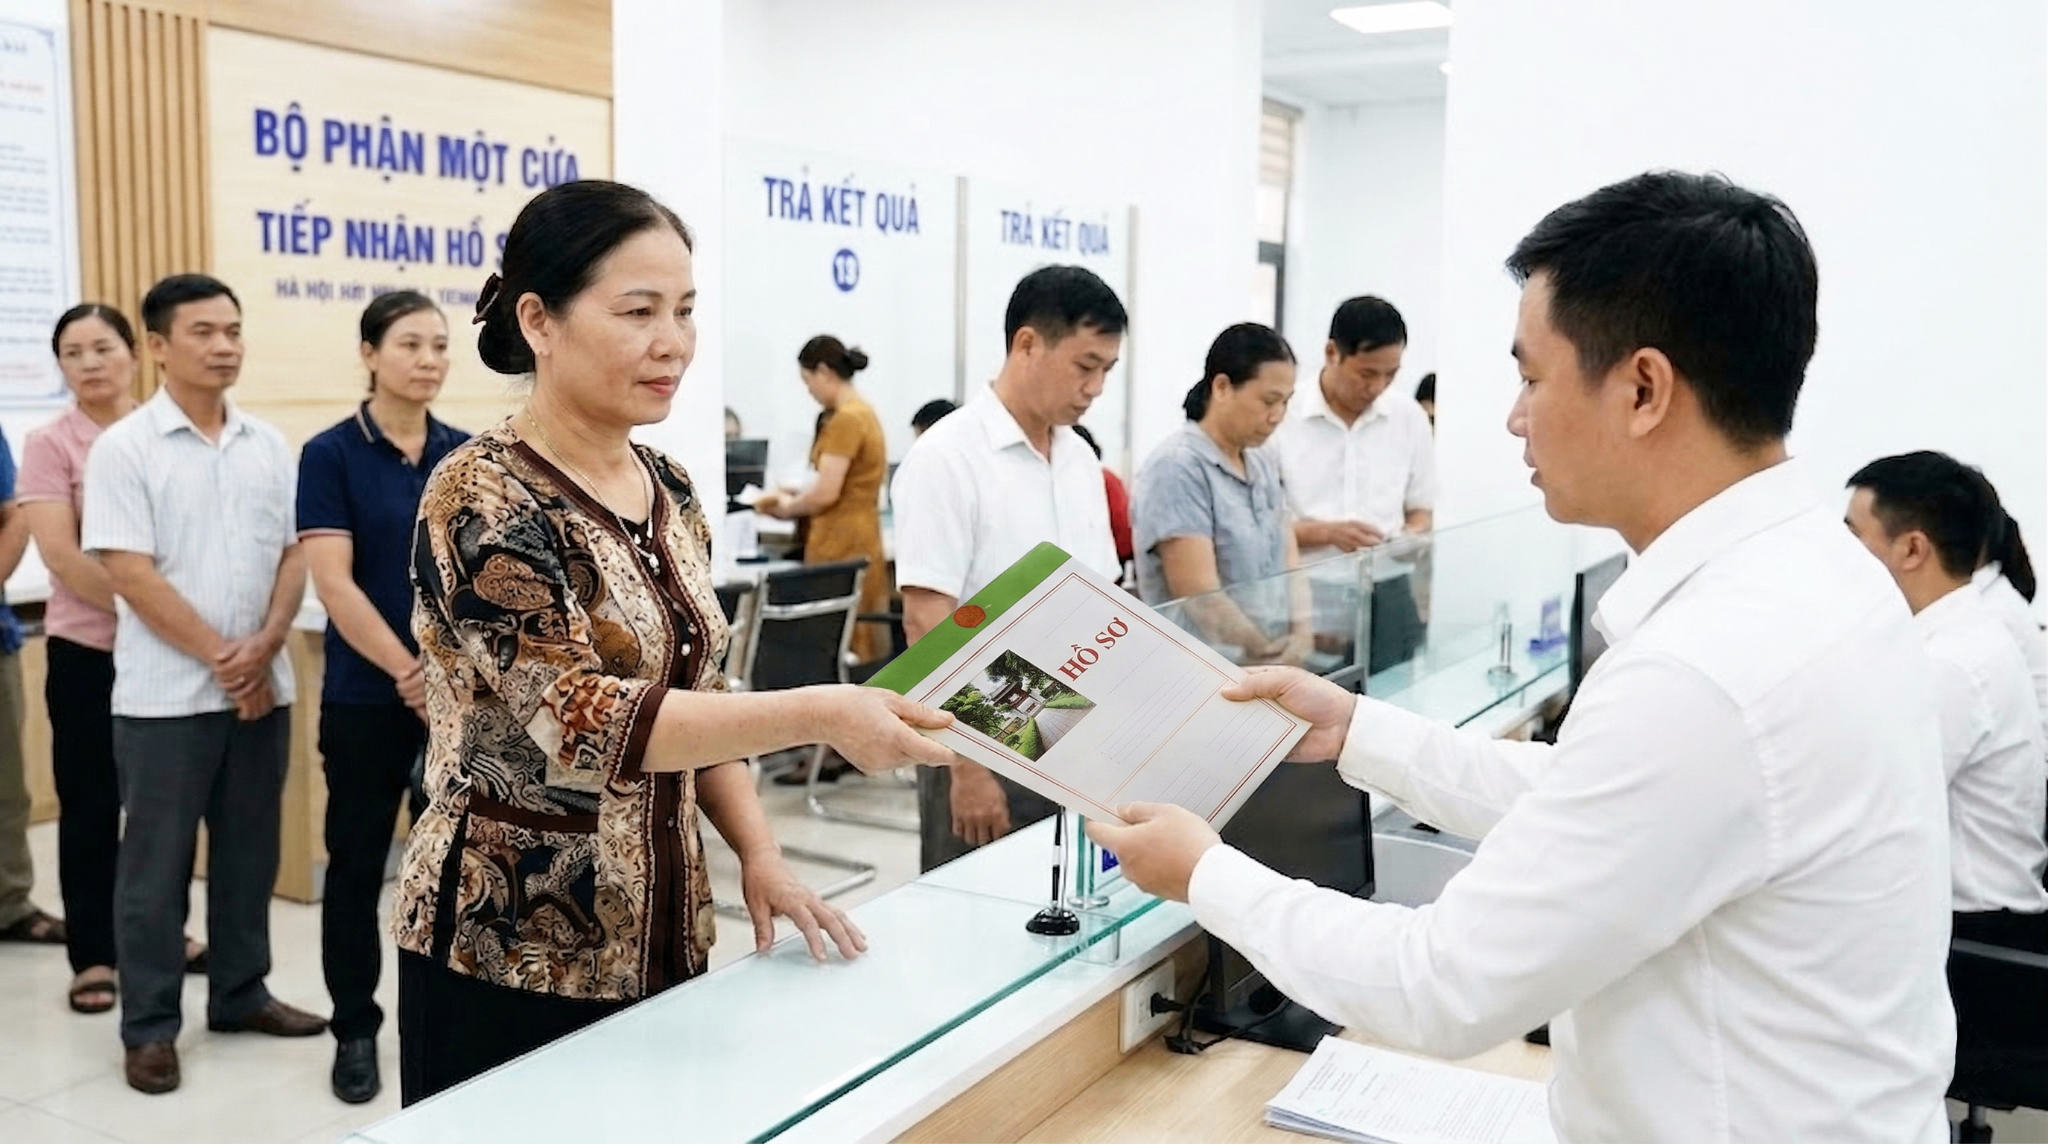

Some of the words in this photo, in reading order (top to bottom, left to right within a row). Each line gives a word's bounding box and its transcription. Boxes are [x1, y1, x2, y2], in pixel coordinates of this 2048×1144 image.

[255, 101, 308, 173] BỘ
[323, 115, 425, 183] PHẬN
[438, 129, 509, 193] MỘT
[823, 173, 866, 228] KẾT
[256, 199, 333, 255] TIẾP
[345, 213, 434, 272] NHẬN
[1057, 643, 1099, 682] HỒ
[1095, 616, 1128, 650] SƠ
